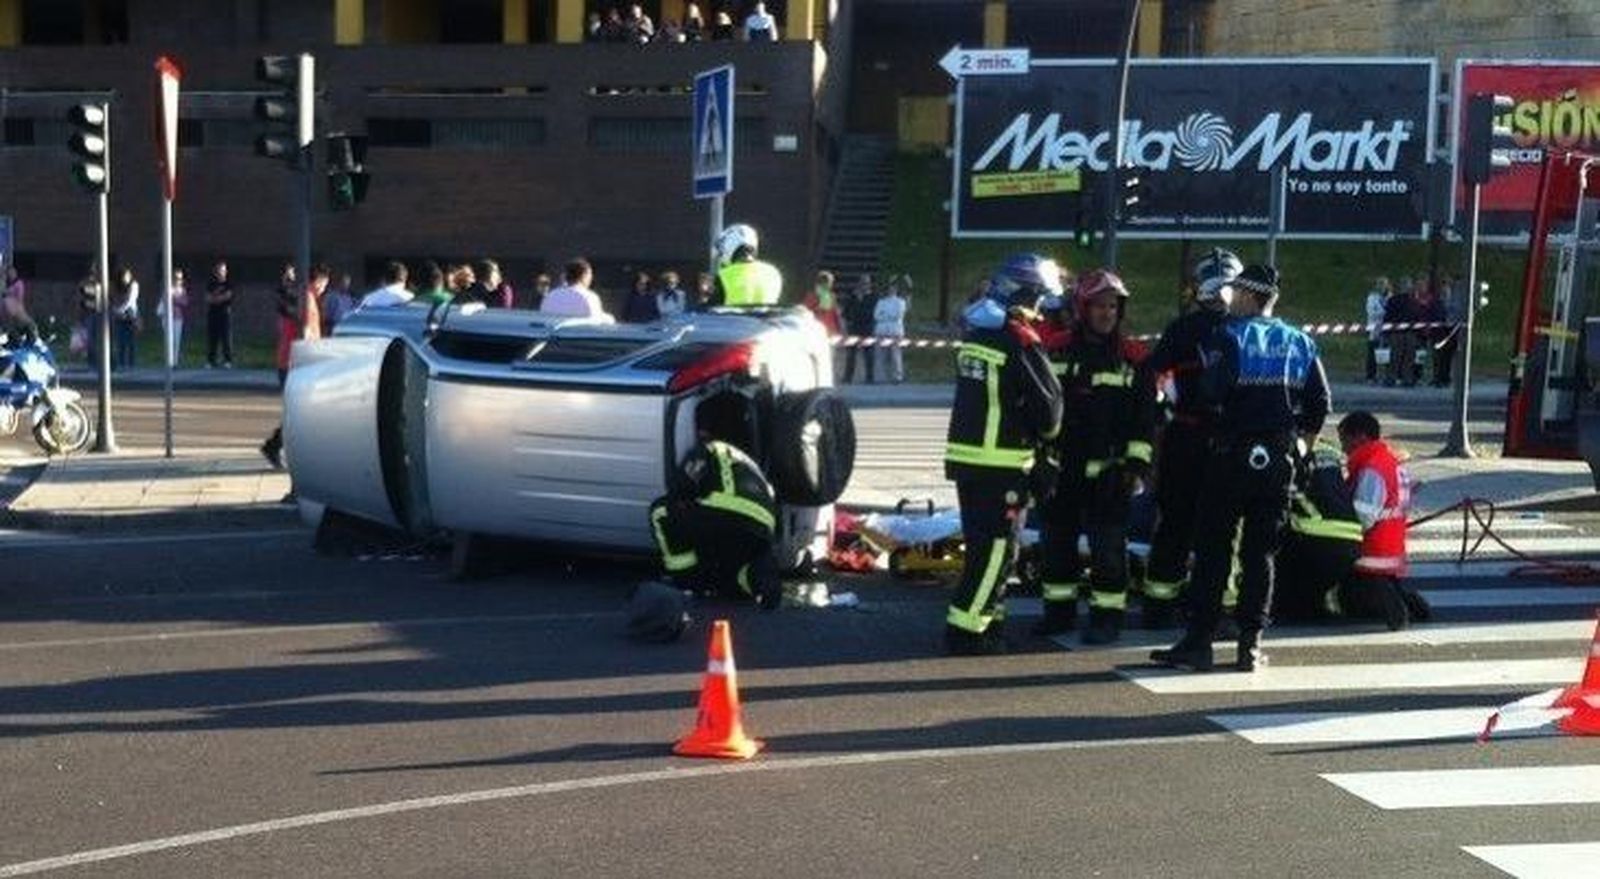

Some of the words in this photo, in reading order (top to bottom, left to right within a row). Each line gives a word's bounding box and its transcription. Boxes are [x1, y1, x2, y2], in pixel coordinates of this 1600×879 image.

[960, 54, 971, 69] 2
[976, 53, 1016, 70] min.
[1219, 112, 1410, 172] Markt
[1288, 178, 1309, 193] Yo
[1312, 181, 1332, 193] no
[1335, 181, 1361, 196] soy
[1365, 178, 1408, 194] tonto
